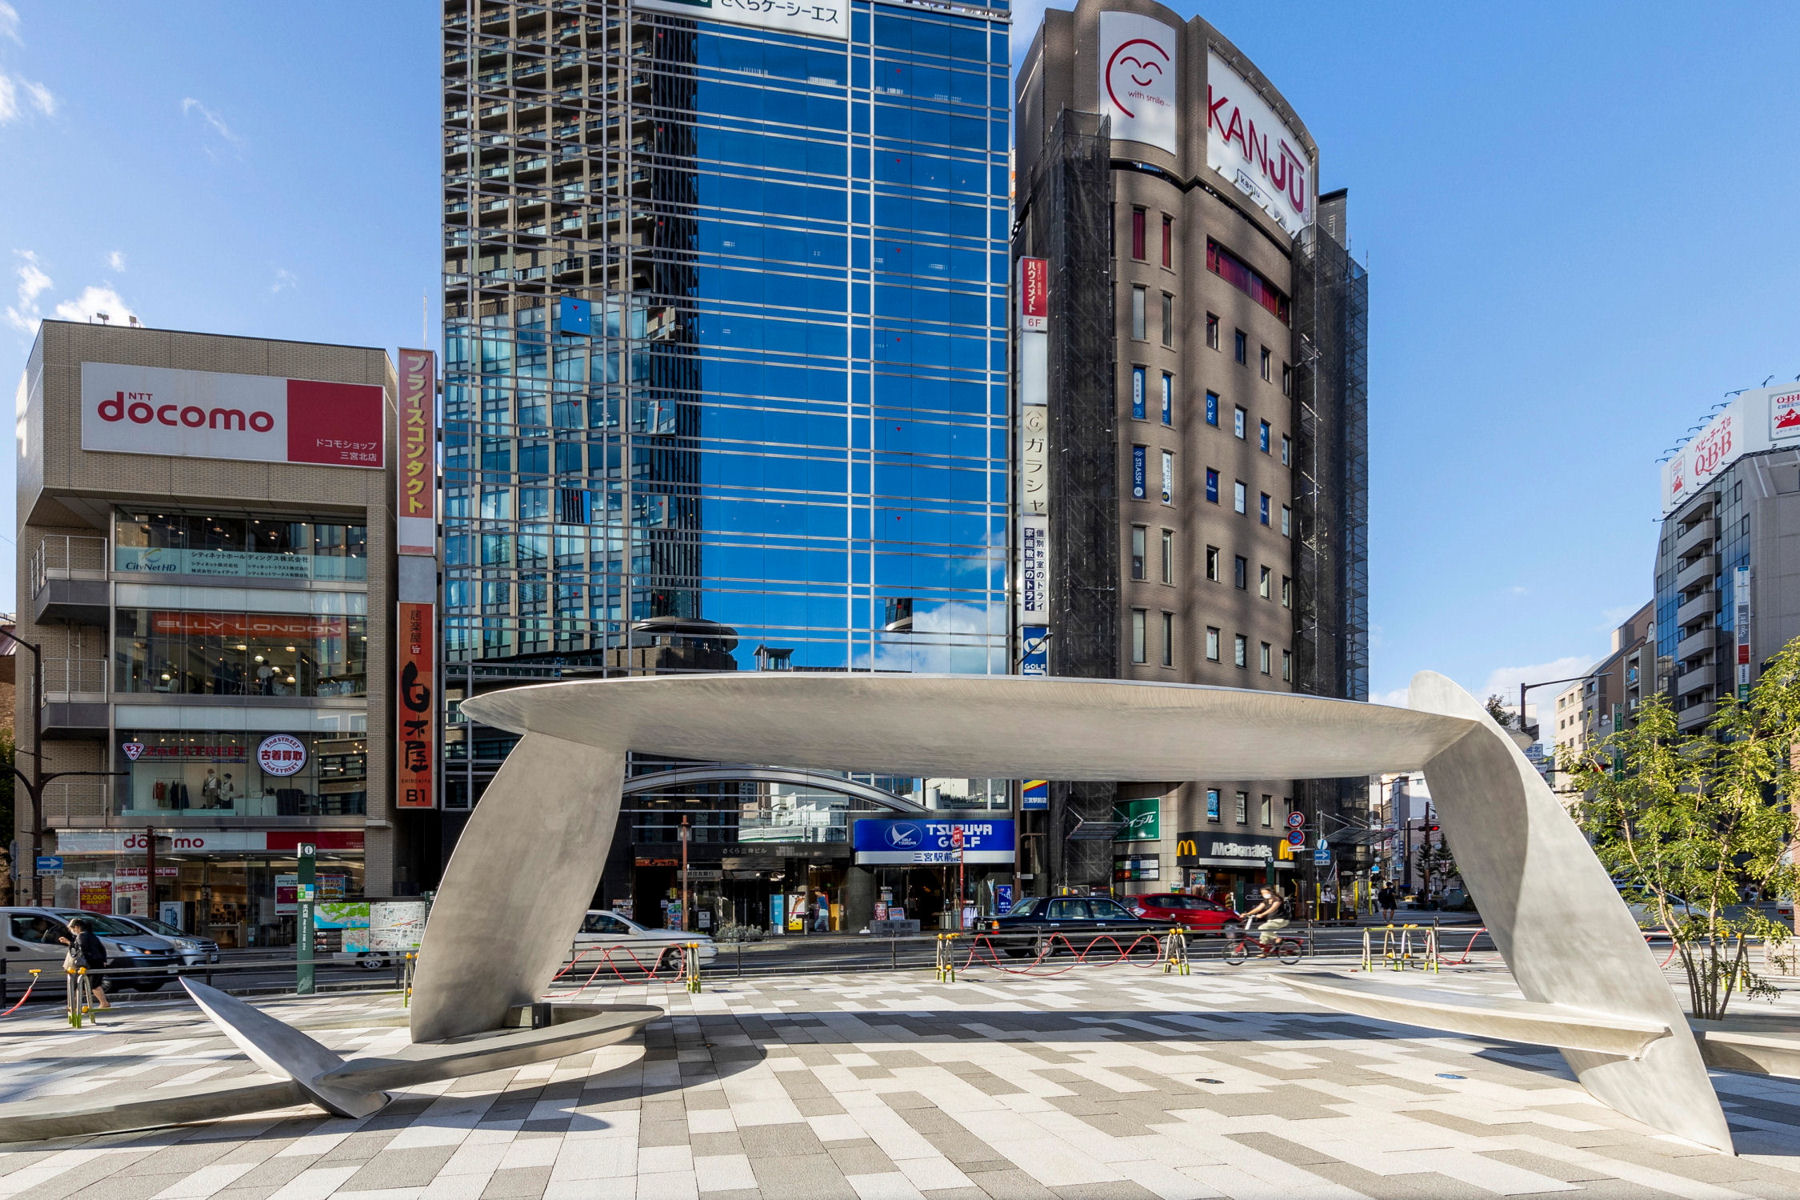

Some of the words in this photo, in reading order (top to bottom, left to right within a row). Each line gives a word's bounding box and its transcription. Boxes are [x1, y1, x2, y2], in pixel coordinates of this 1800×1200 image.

[1128, 90, 1145, 100] with
[1147, 95, 1165, 106] smile
[1027, 261, 1036, 314] ハウスメイト
[1028, 318, 1041, 328] 6F
[128, 391, 153, 401] NTT
[97, 391, 274, 433] docomo
[406, 355, 428, 514] プライスコンタクト
[316, 438, 377, 451] ドコモショップ
[340, 451, 377, 462] 三宮北店
[1025, 438, 1044, 507] ガラシャ
[1025, 529, 1034, 610] 家庭教師のトライ
[1036, 529, 1045, 610] 個別教室のトライ
[157, 620, 225, 630] ELLY
[235, 622, 342, 634] LONDON
[402, 661, 430, 773] 白木屋
[145, 745, 179, 757] 2nd
[183, 745, 246, 757] STREET
[261, 750, 303, 761] 古着買取
[406, 789, 426, 802] B1
[123, 833, 205, 848] domo
[1211, 842, 1273, 858] McDonald's
